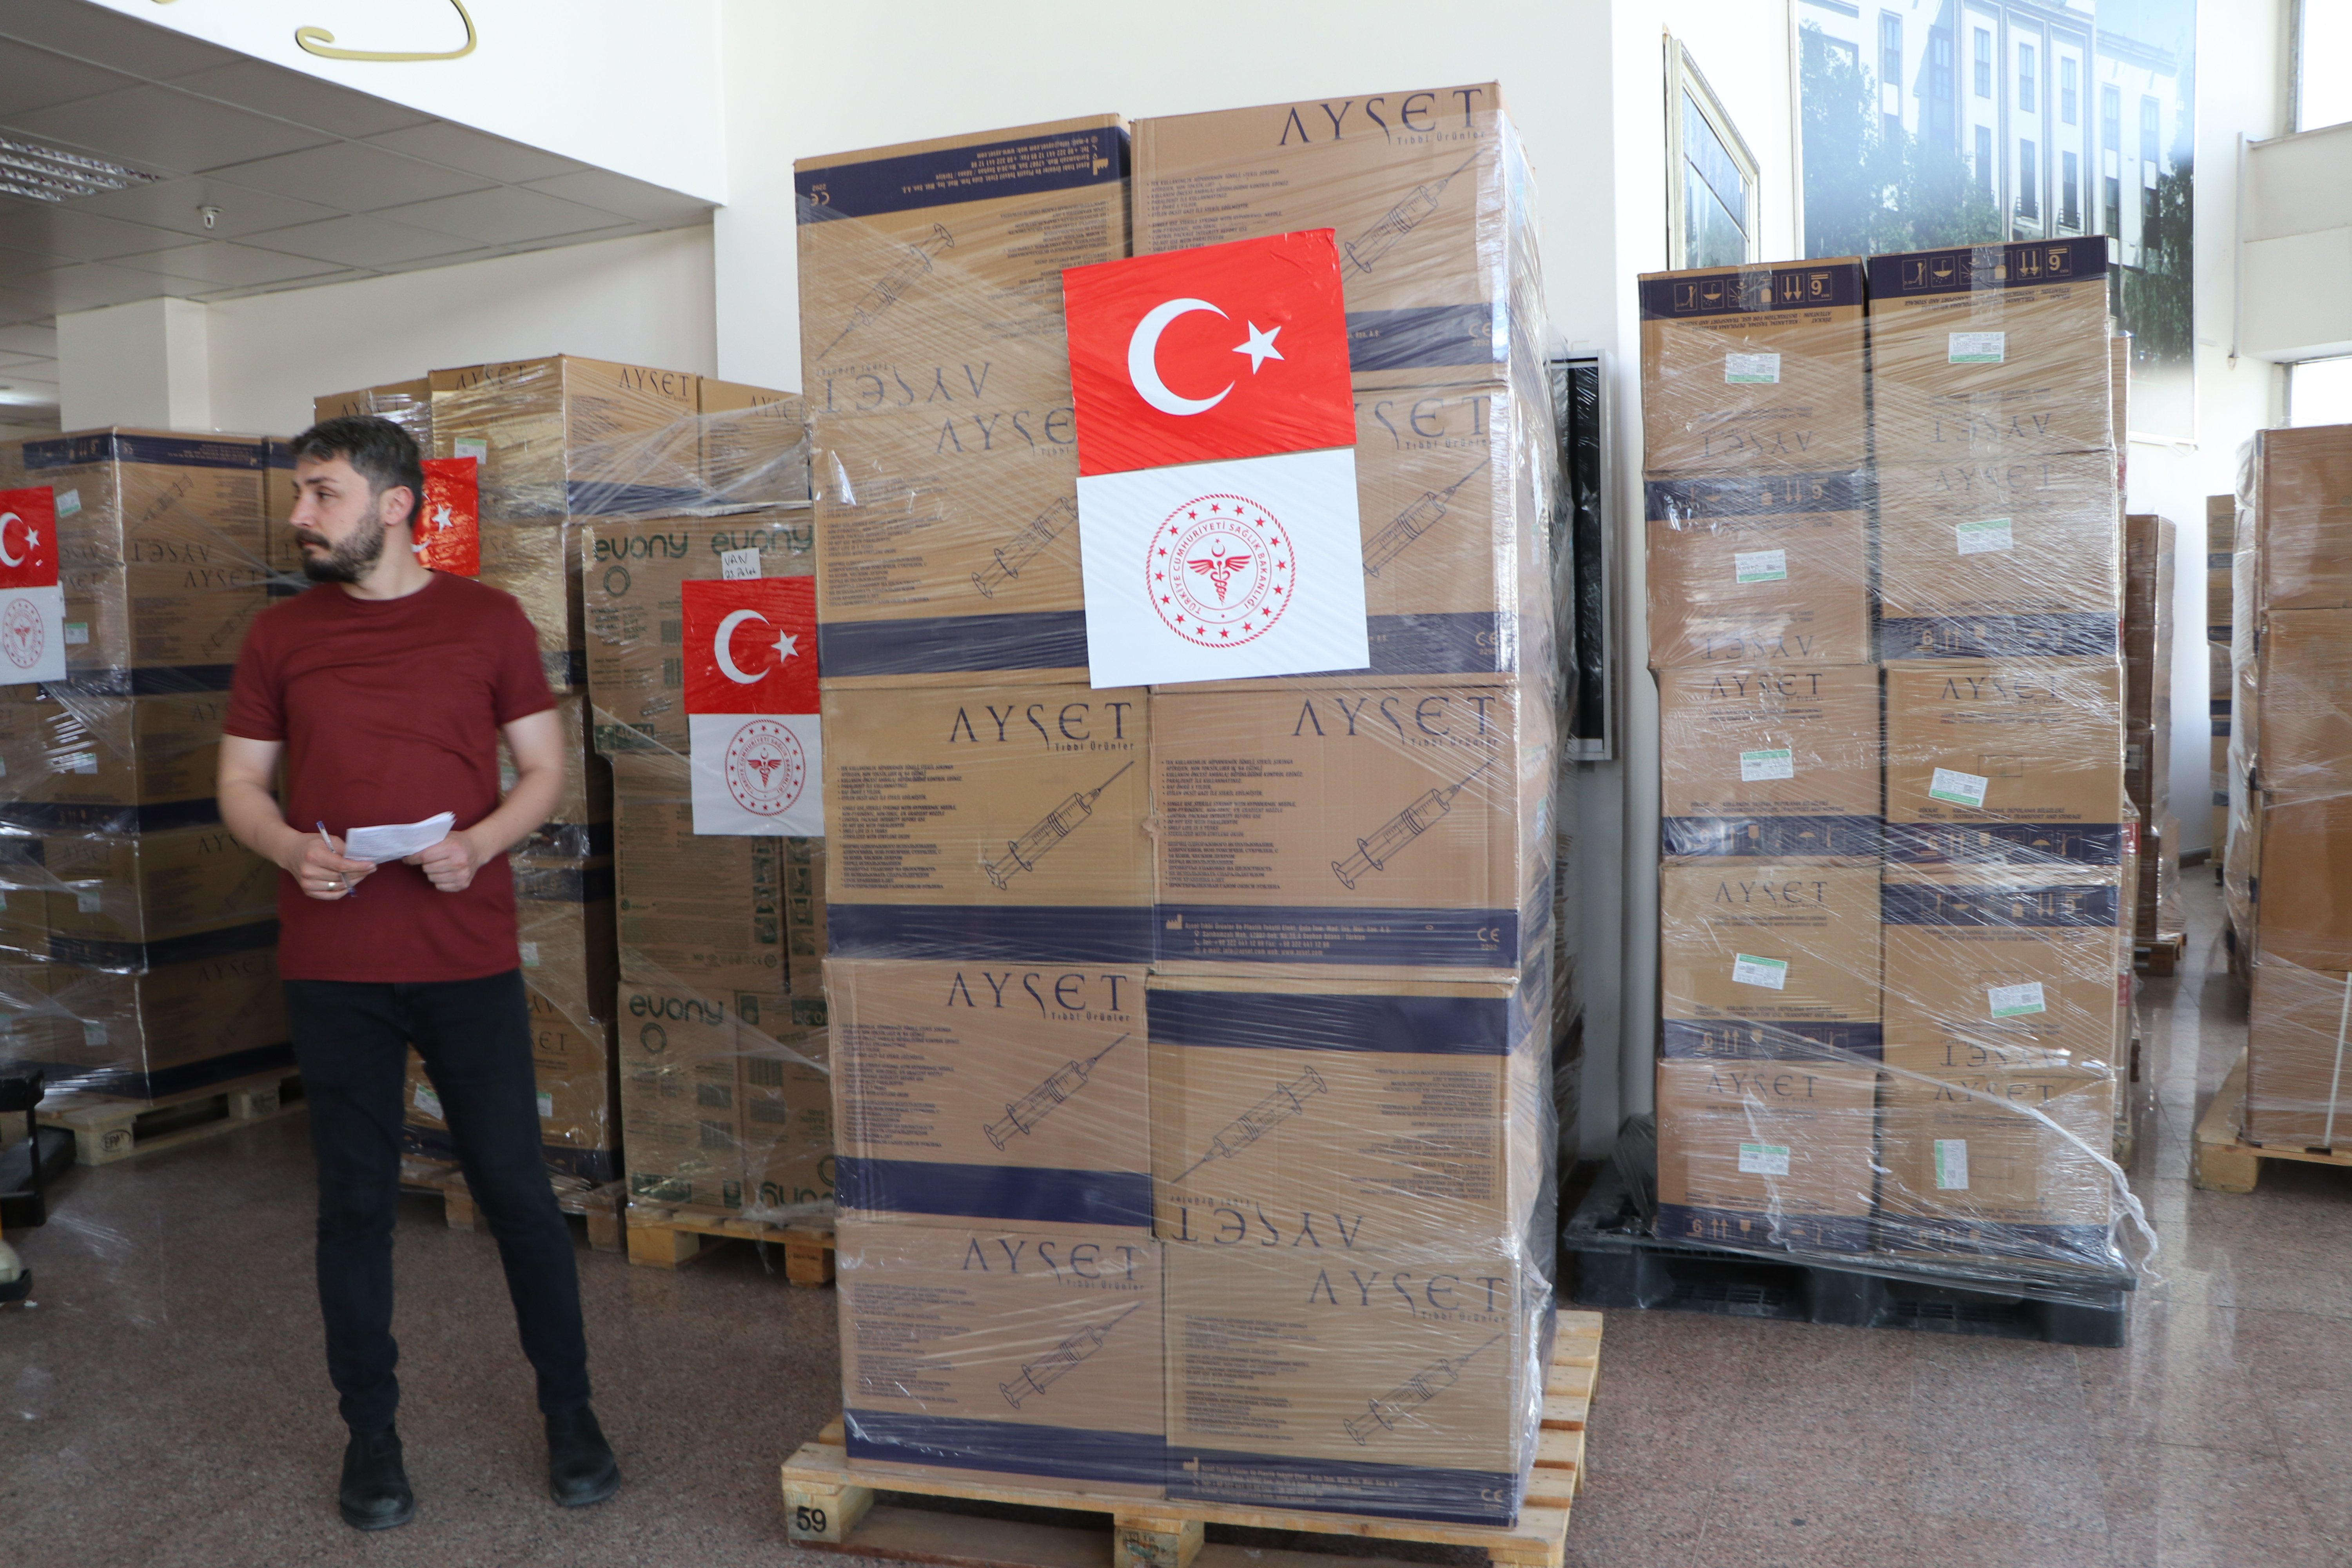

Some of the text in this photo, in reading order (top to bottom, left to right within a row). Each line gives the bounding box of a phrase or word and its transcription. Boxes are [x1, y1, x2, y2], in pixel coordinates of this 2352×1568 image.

[1277, 89, 1482, 147] AYSET
[1436, 131, 1485, 143] Ürünler
[619, 367, 690, 396] AYSET
[819, 361, 991, 415] AYSET
[936, 407, 1076, 456] AYSE
[594, 532, 688, 562] evony
[1173, 520, 1269, 615] TÜRKİYE CUMHURİYETİ SAĞLIK BAKANLIĞI
[949, 702, 1131, 751] AYSET
[1292, 695, 1496, 744] AYSET
[1090, 740, 1135, 751] Ürünler
[629, 994, 724, 1026] evony
[947, 971, 1127, 1019] AYSET
[1086, 1010, 1131, 1022] Ürünler
[1172, 1201, 1363, 1248] AYSET
[962, 1237, 1140, 1285] AYSET
[1308, 1268, 1504, 1318] AYSET
[796, 1506, 826, 1533] 59
